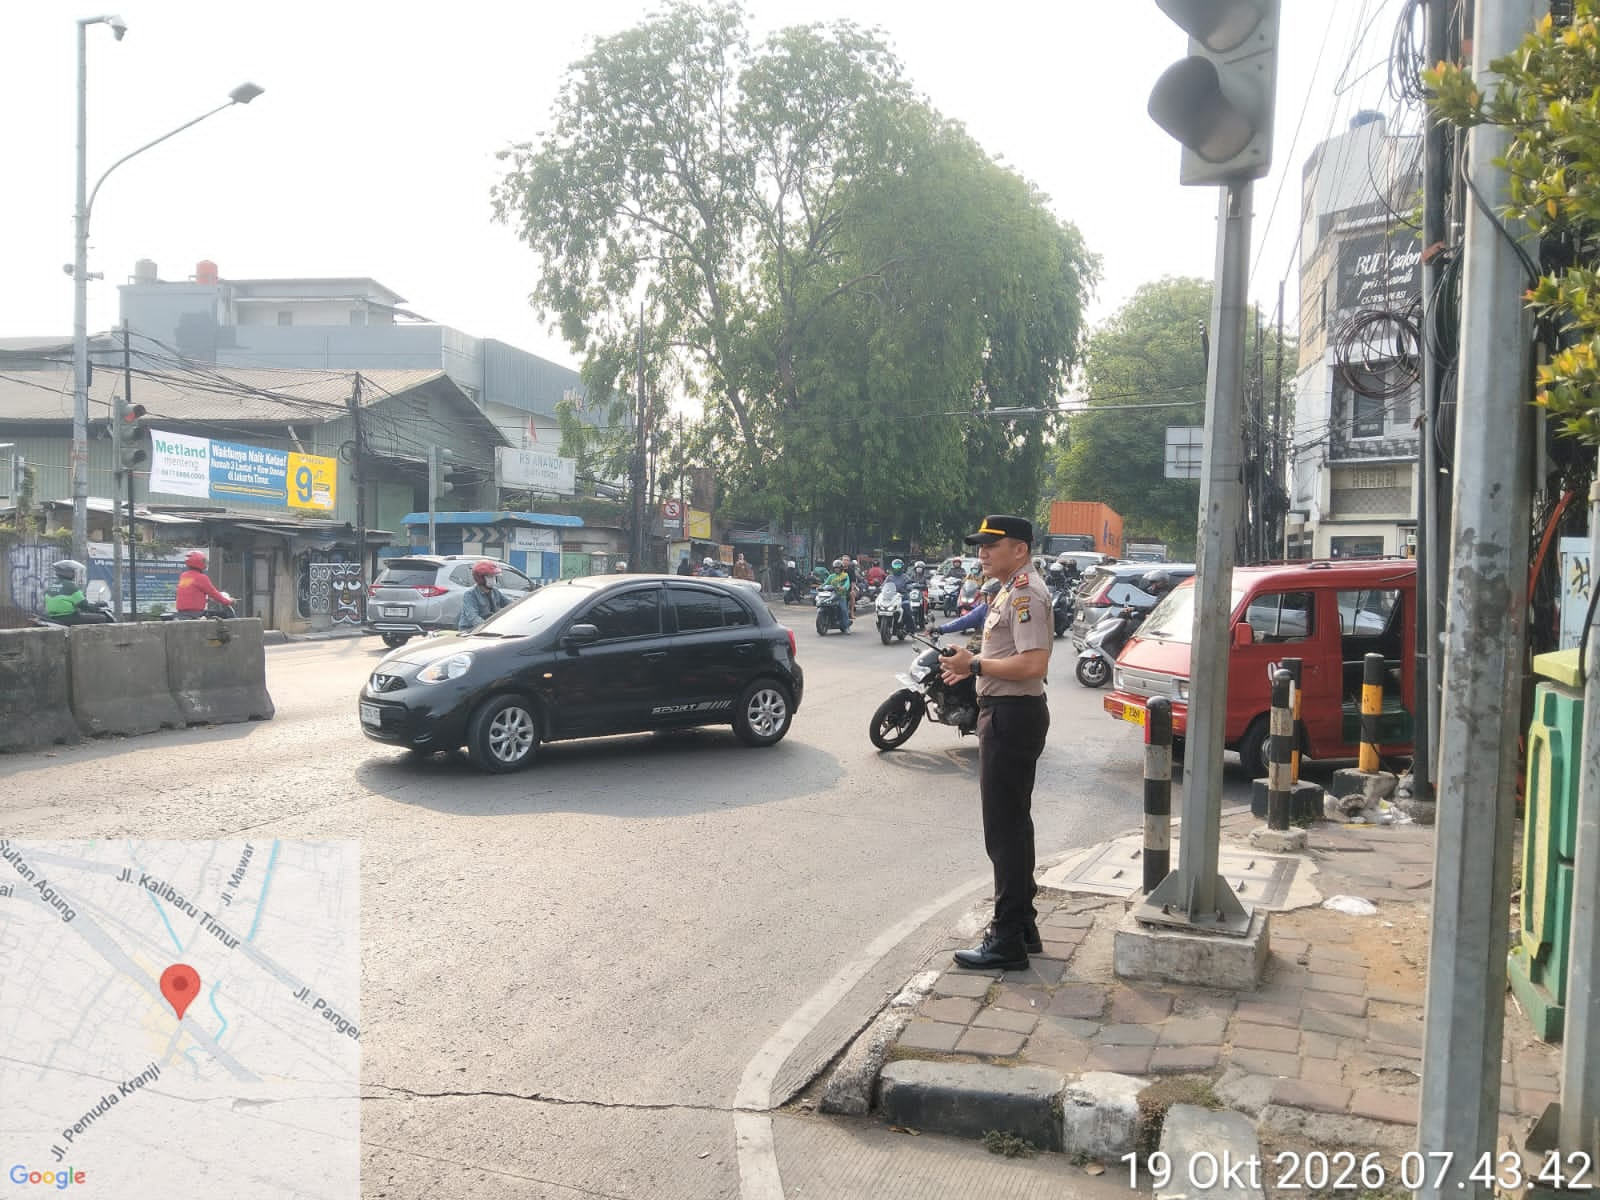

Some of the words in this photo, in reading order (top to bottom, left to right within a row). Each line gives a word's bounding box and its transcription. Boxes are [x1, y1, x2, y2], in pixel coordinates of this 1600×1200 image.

[154, 440, 207, 459] Metland
[212, 444, 247, 463] Waktunya
[248, 450, 264, 463] Naik
[295, 465, 313, 503] 9
[652, 703, 697, 714] SPORT
